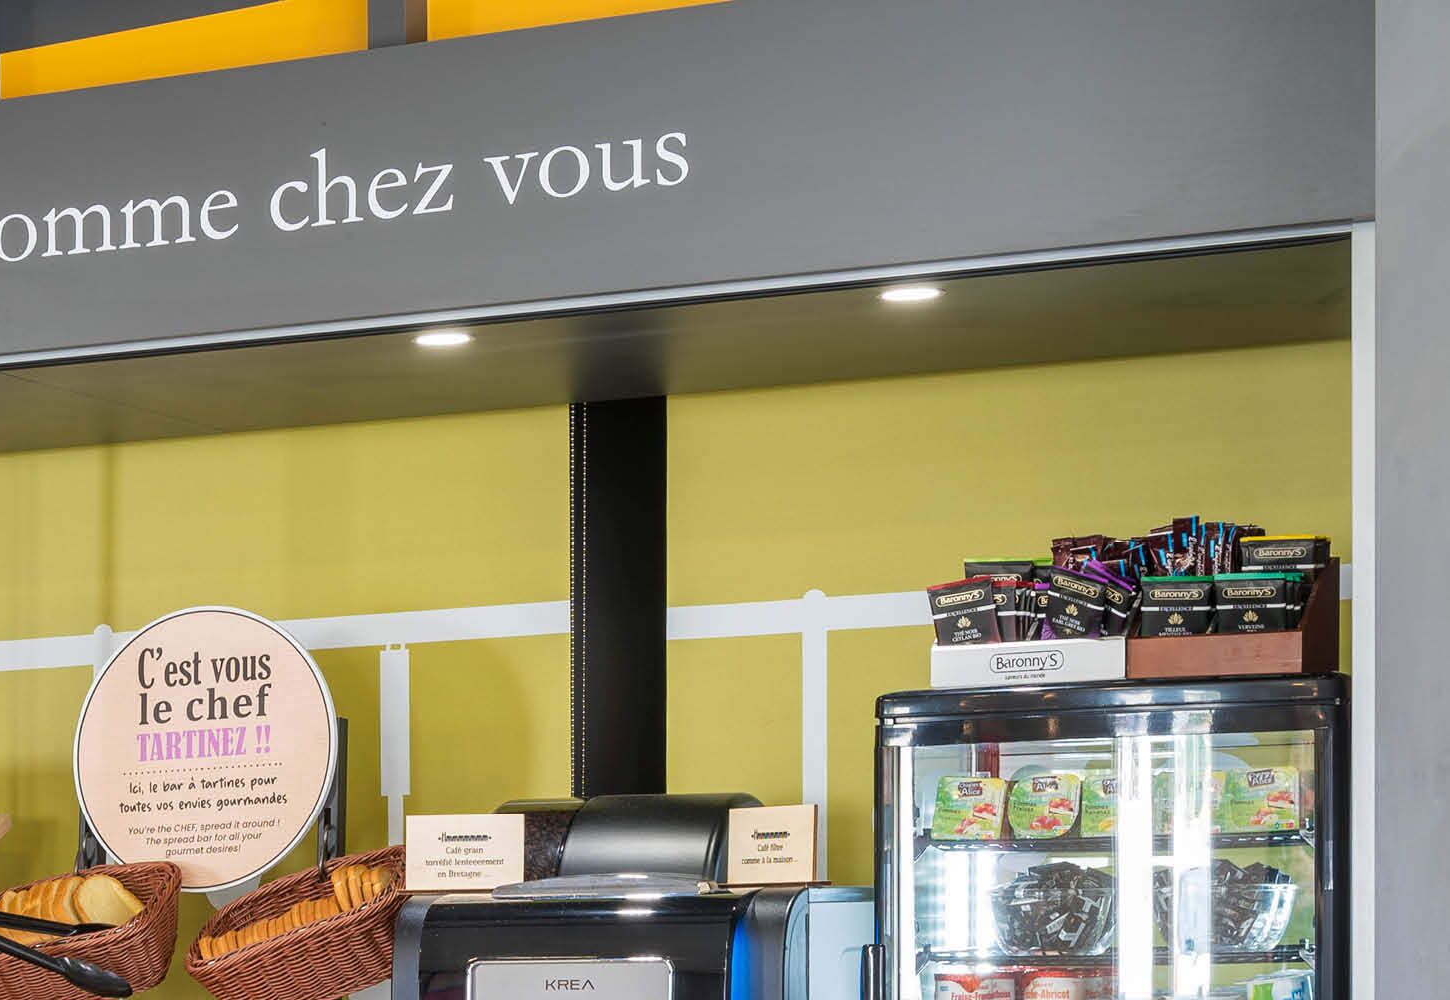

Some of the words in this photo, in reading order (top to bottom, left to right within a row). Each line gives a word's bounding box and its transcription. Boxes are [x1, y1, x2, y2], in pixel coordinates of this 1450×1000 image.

[269, 148, 455, 231] chez
[483, 130, 691, 205] vous
[138, 647, 202, 689] C'est
[210, 652, 272, 684] vous
[996, 653, 1058, 671] Baronny'S
[138, 692, 173, 725] le
[186, 683, 272, 722] chef
[136, 725, 247, 763] TARTINEZ
[255, 724, 272, 754] !!
[129, 781, 144, 796] Ici,
[149, 782, 158, 794] le
[162, 780, 184, 793] bar
[188, 776, 197, 790] à
[200, 776, 246, 790] tartines
[250, 775, 278, 791] pour
[119, 800, 152, 814] toutes
[156, 800, 174, 812] vos
[178, 797, 213, 811] envies
[216, 792, 288, 812] gourmandes
[128, 825, 156, 836] You're
[157, 824, 172, 834] the
[173, 823, 198, 833] CHEF,
[200, 820, 233, 832] spread
[234, 819, 241, 830] it
[241, 818, 276, 829] around
[145, 837, 162, 846] The
[163, 834, 196, 847] spread
[196, 833, 213, 843] bar
[214, 832, 228, 842] for
[228, 832, 241, 842] all
[241, 831, 263, 843] your
[165, 847, 204, 858] gourmet
[205, 843, 241, 855] desires!
[445, 846, 462, 855] Café
[463, 846, 484, 856] grain
